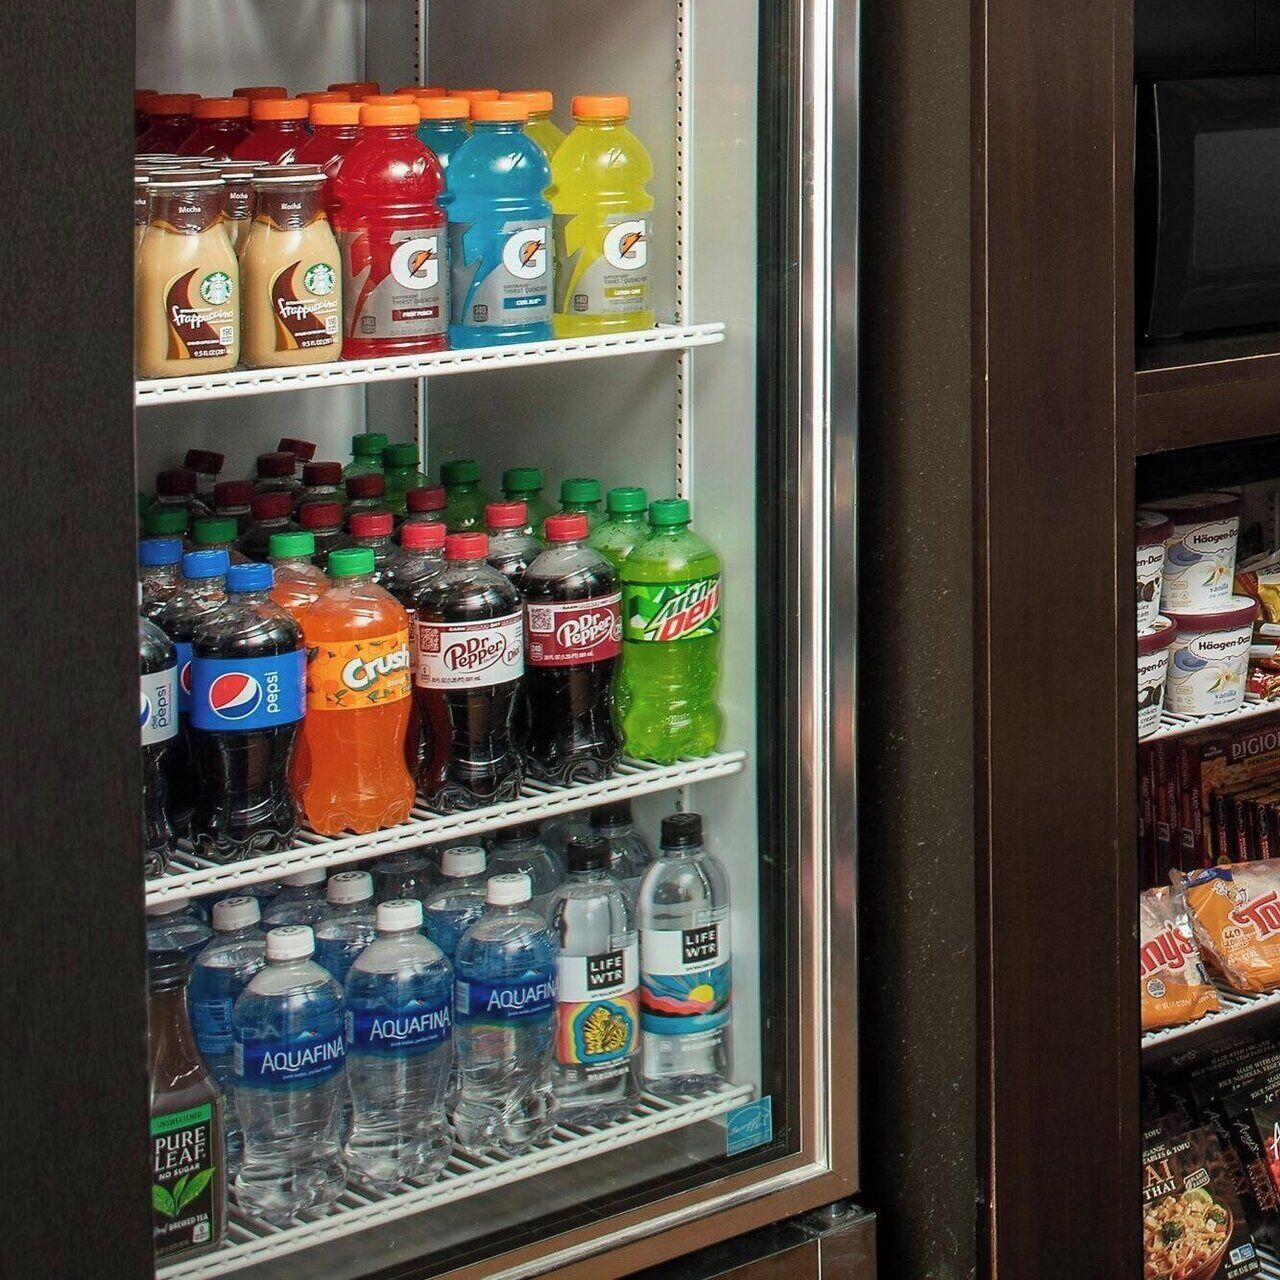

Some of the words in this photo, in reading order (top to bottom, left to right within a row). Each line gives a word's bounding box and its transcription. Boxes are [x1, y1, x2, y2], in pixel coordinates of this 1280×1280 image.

[230, 191, 249, 200] Mocha
[179, 206, 202, 214] Mocha
[503, 226, 548, 280] G
[603, 220, 648, 271] G
[390, 235, 440, 291] G
[172, 306, 234, 330] frappuccino
[279, 297, 339, 322] frappuccino
[564, 616, 612, 648] Pepper
[579, 613, 601, 626] Dr
[448, 640, 504, 671] Pepper
[466, 637, 490, 652] Dr
[342, 642, 411, 689] Crush
[265, 670, 280, 714] pepsi
[158, 684, 169, 729] pepsi
[684, 943, 718, 957] WTR
[685, 930, 717, 945] LIFE
[589, 956, 622, 972] LIFE
[590, 969, 623, 985] WTR
[487, 981, 557, 1011] AQUAFIN
[369, 1006, 452, 1042] AQUAFINA
[261, 1035, 345, 1075] AQUAFINA
[155, 1126, 206, 1152] PURE
[1173, 1142, 1191, 1152] TOFU
[154, 1142, 206, 1170] LEAF
[158, 1169, 171, 1180] NO
[173, 1163, 201, 1177] SUGAR
[1143, 1180, 1177, 1200] THAI
[196, 1213, 209, 1223] TEA
